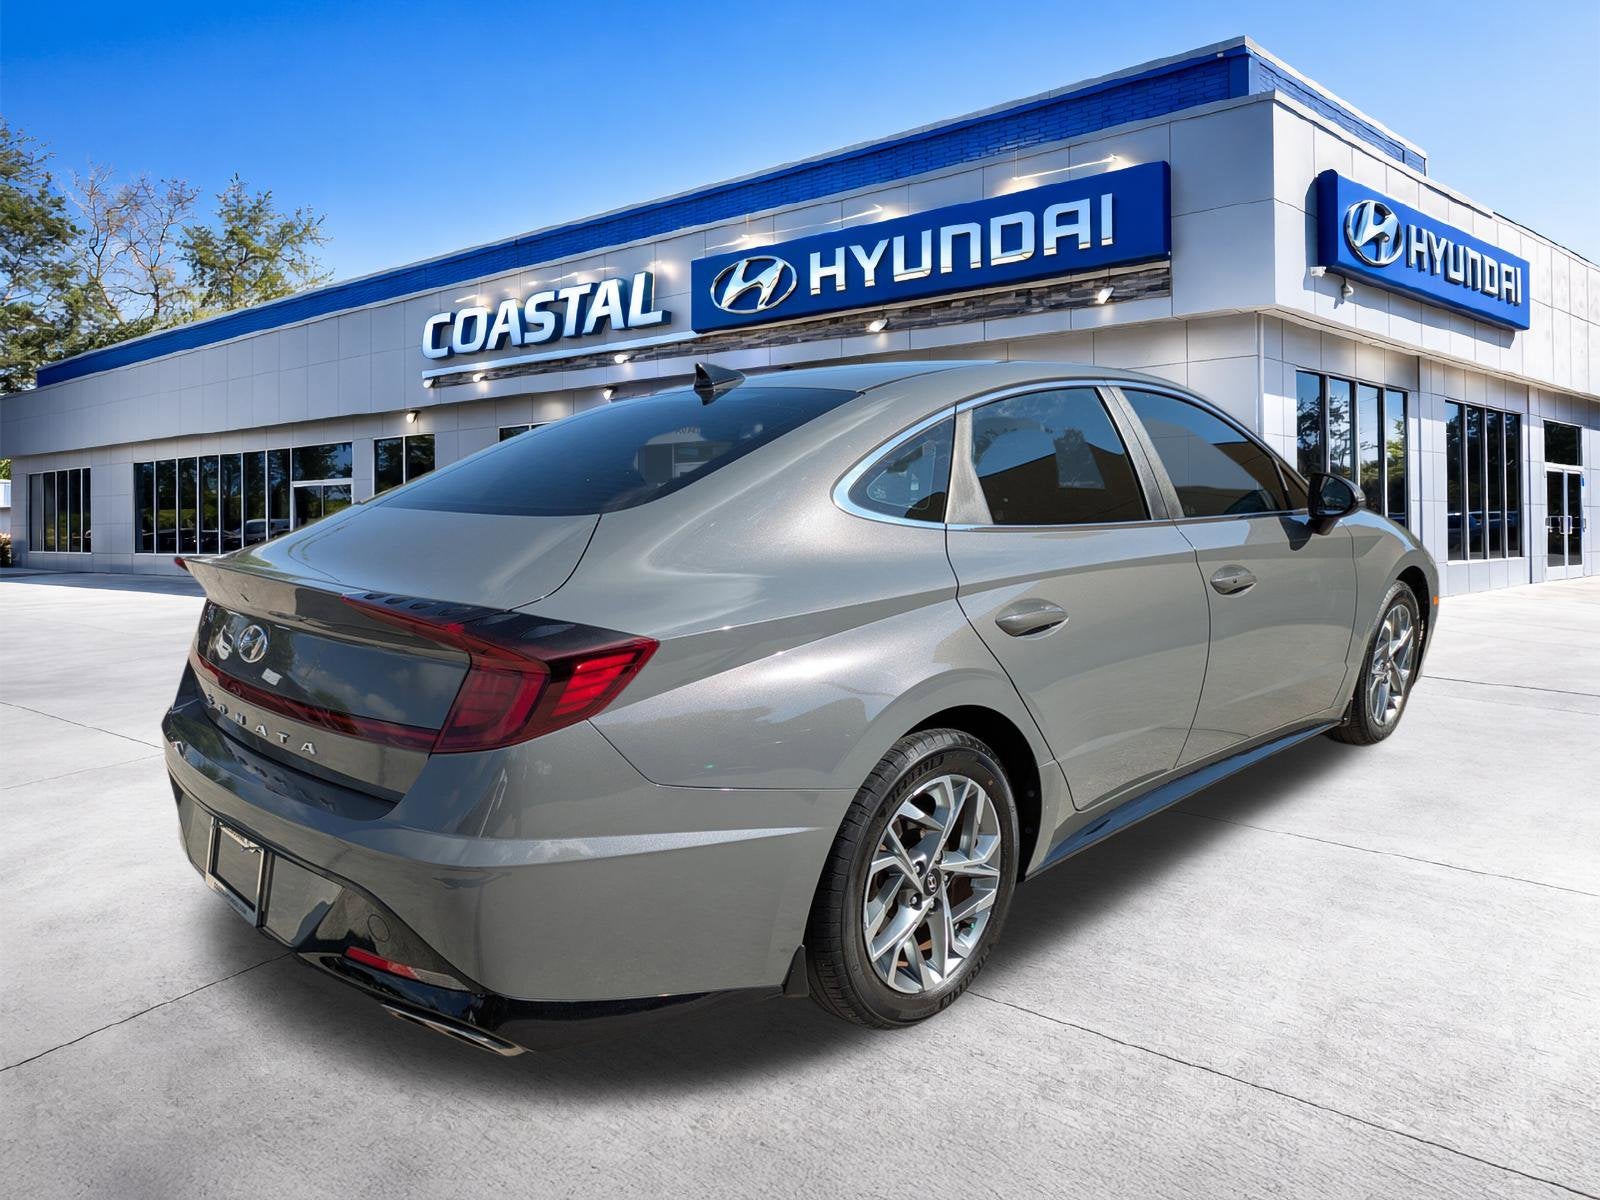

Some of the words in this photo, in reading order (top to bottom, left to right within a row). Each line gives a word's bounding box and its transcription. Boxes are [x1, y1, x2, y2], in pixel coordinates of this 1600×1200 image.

[810, 192, 1114, 295] HYUNDAI
[1407, 224, 1522, 306] HYUNDAI
[422, 271, 671, 359] COASTAL
[208, 694, 316, 755] SONATA
